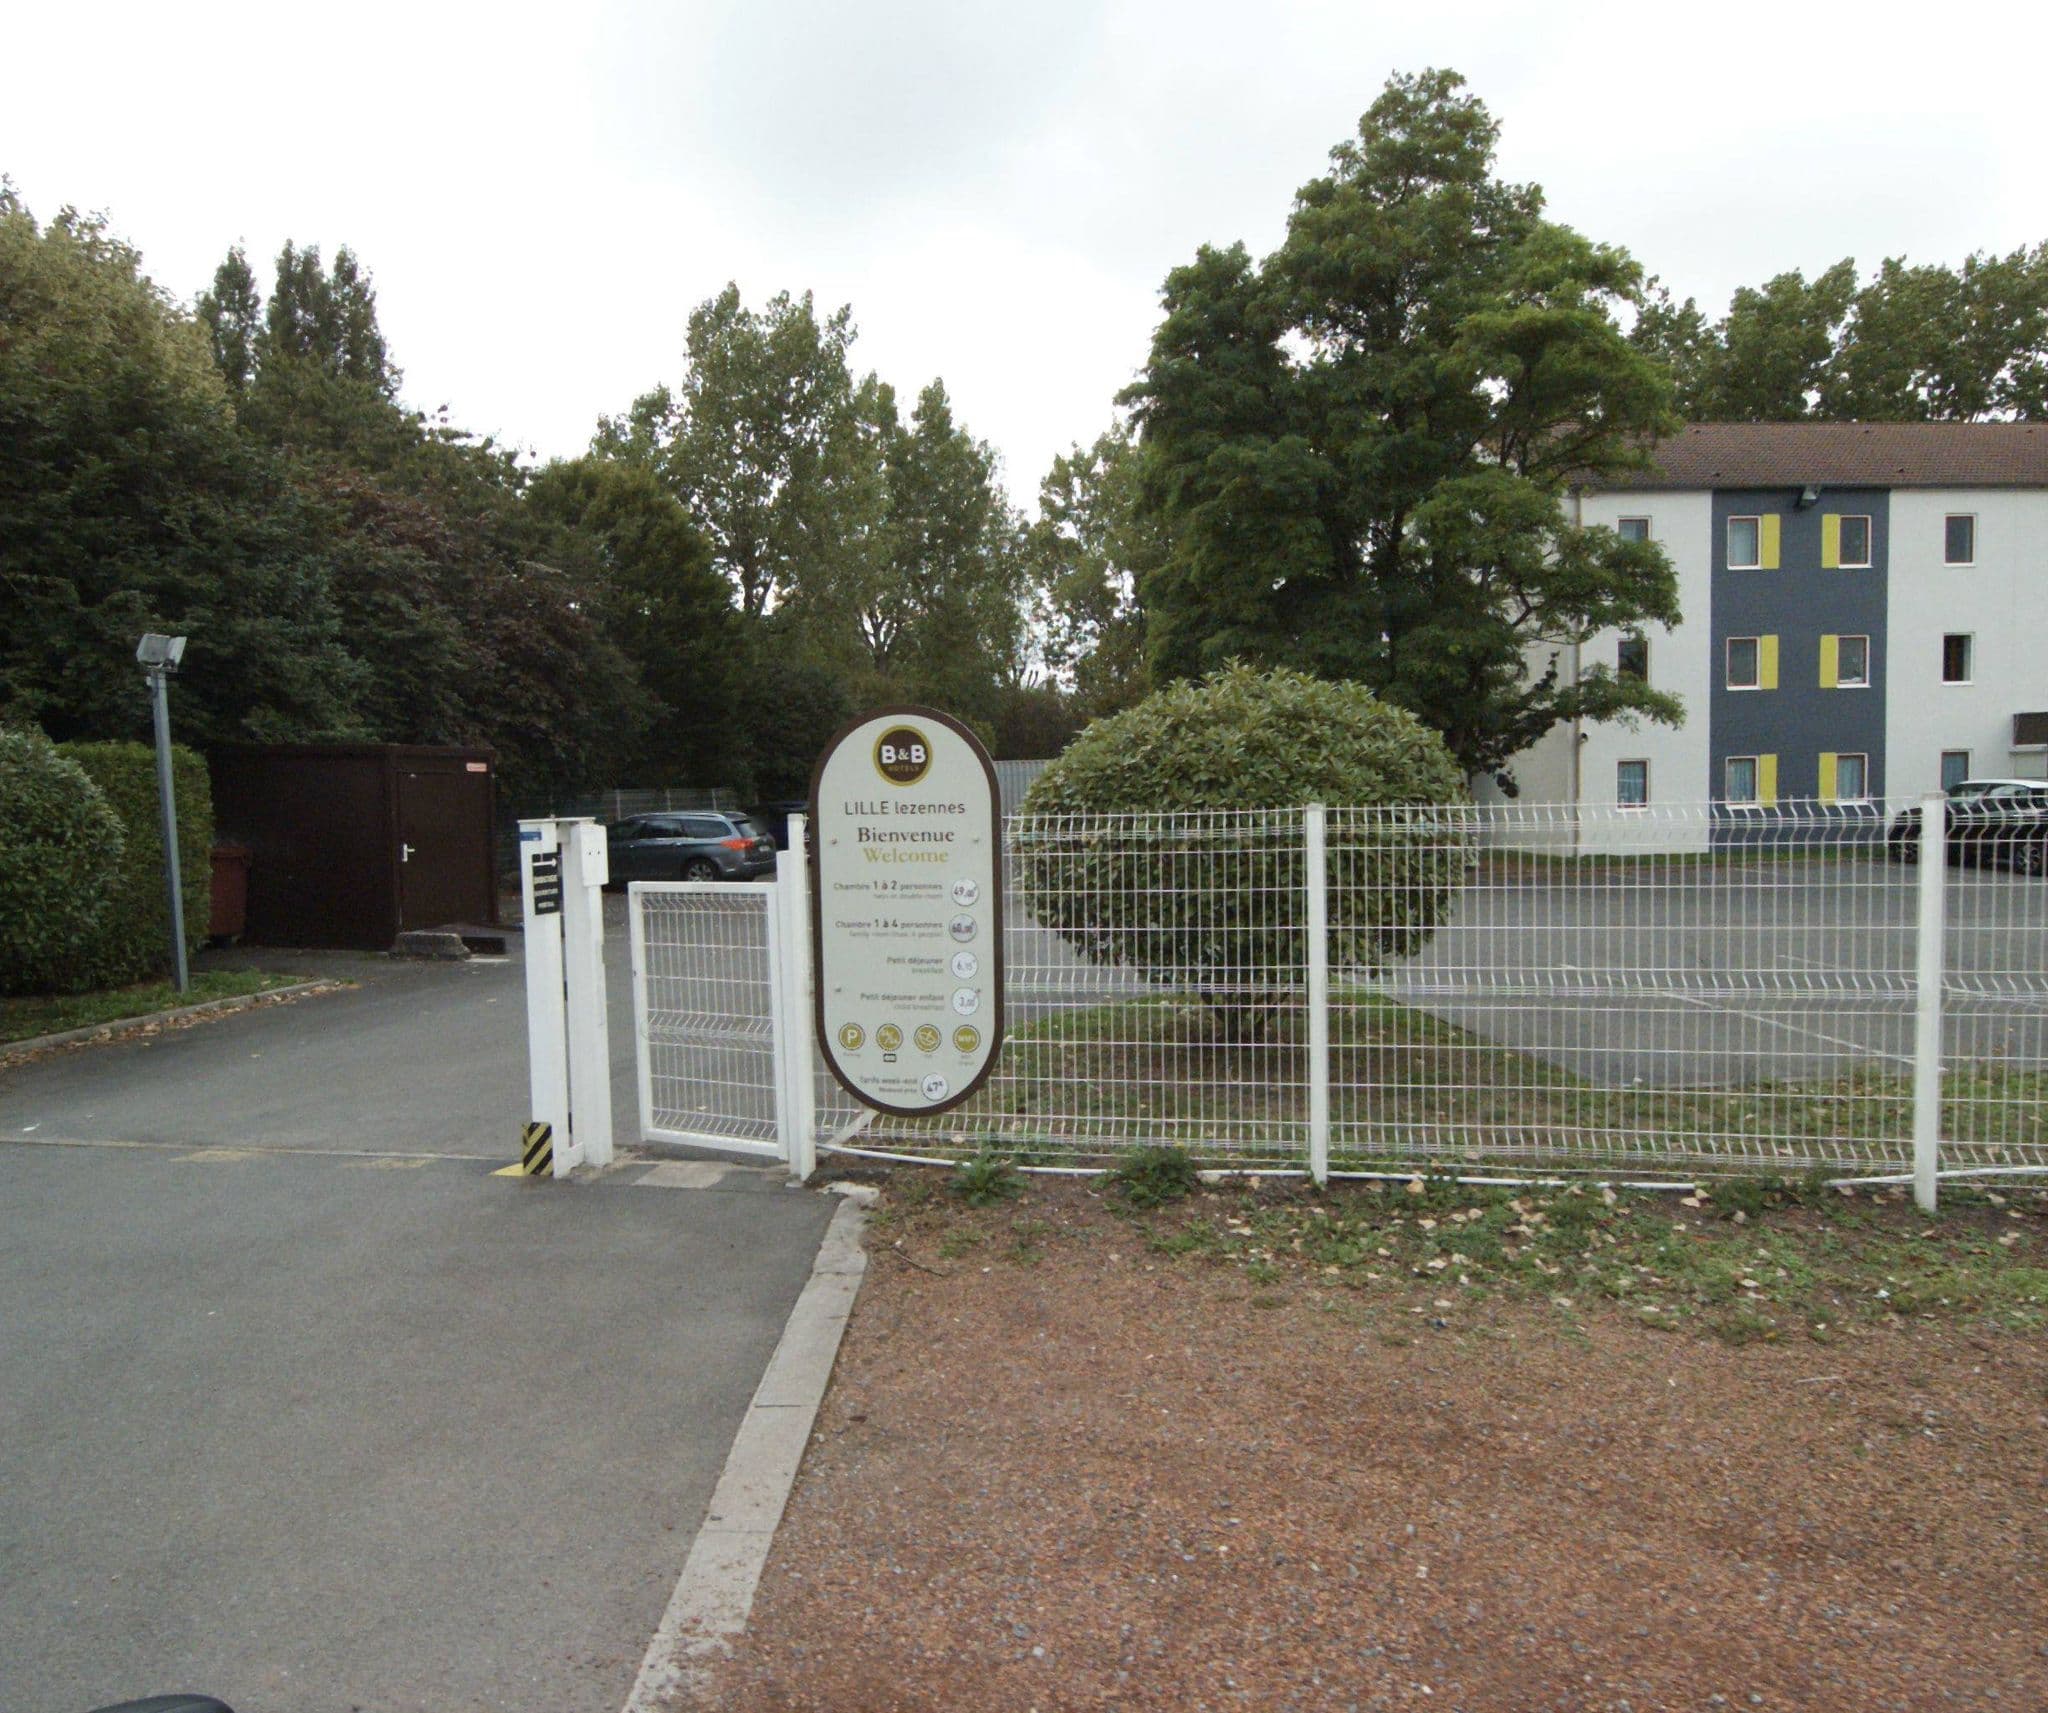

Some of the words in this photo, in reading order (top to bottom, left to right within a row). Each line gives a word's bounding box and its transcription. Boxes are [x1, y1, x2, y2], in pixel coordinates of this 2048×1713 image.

[881, 744, 926, 764] B&B
[844, 801, 889, 816] LILLE
[857, 826, 955, 843] Bienvenue
[863, 847, 949, 863] Welcome
[873, 880, 878, 890] 1
[891, 880, 898, 890] 2
[900, 882, 943, 892] personnes
[874, 918, 879, 928] 1
[891, 918, 898, 928] 4
[900, 921, 943, 930] personnes
[847, 1029, 857, 1044] P
